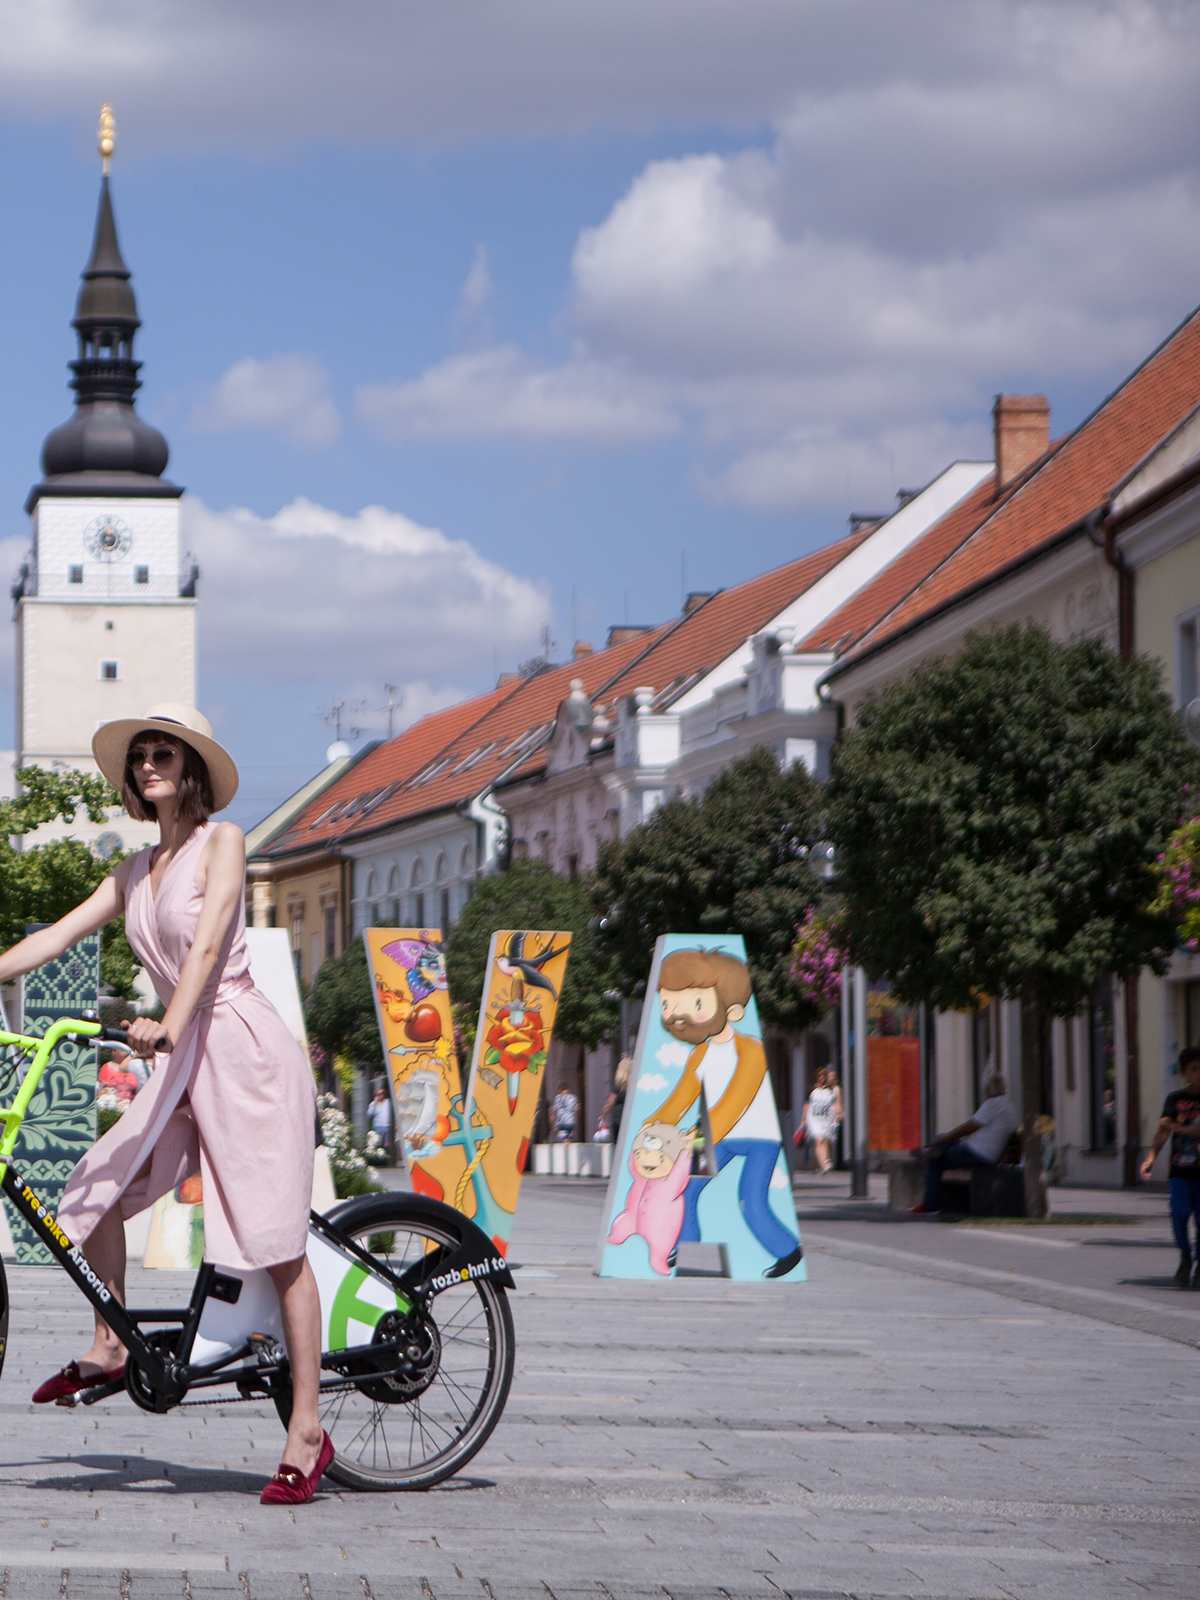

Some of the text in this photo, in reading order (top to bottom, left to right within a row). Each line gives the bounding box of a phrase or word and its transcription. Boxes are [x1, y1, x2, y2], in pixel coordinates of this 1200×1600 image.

[22, 1185, 69, 1248] freebike
[67, 1247, 111, 1302] Arboria
[431, 1257, 506, 1290] rozbehni to
